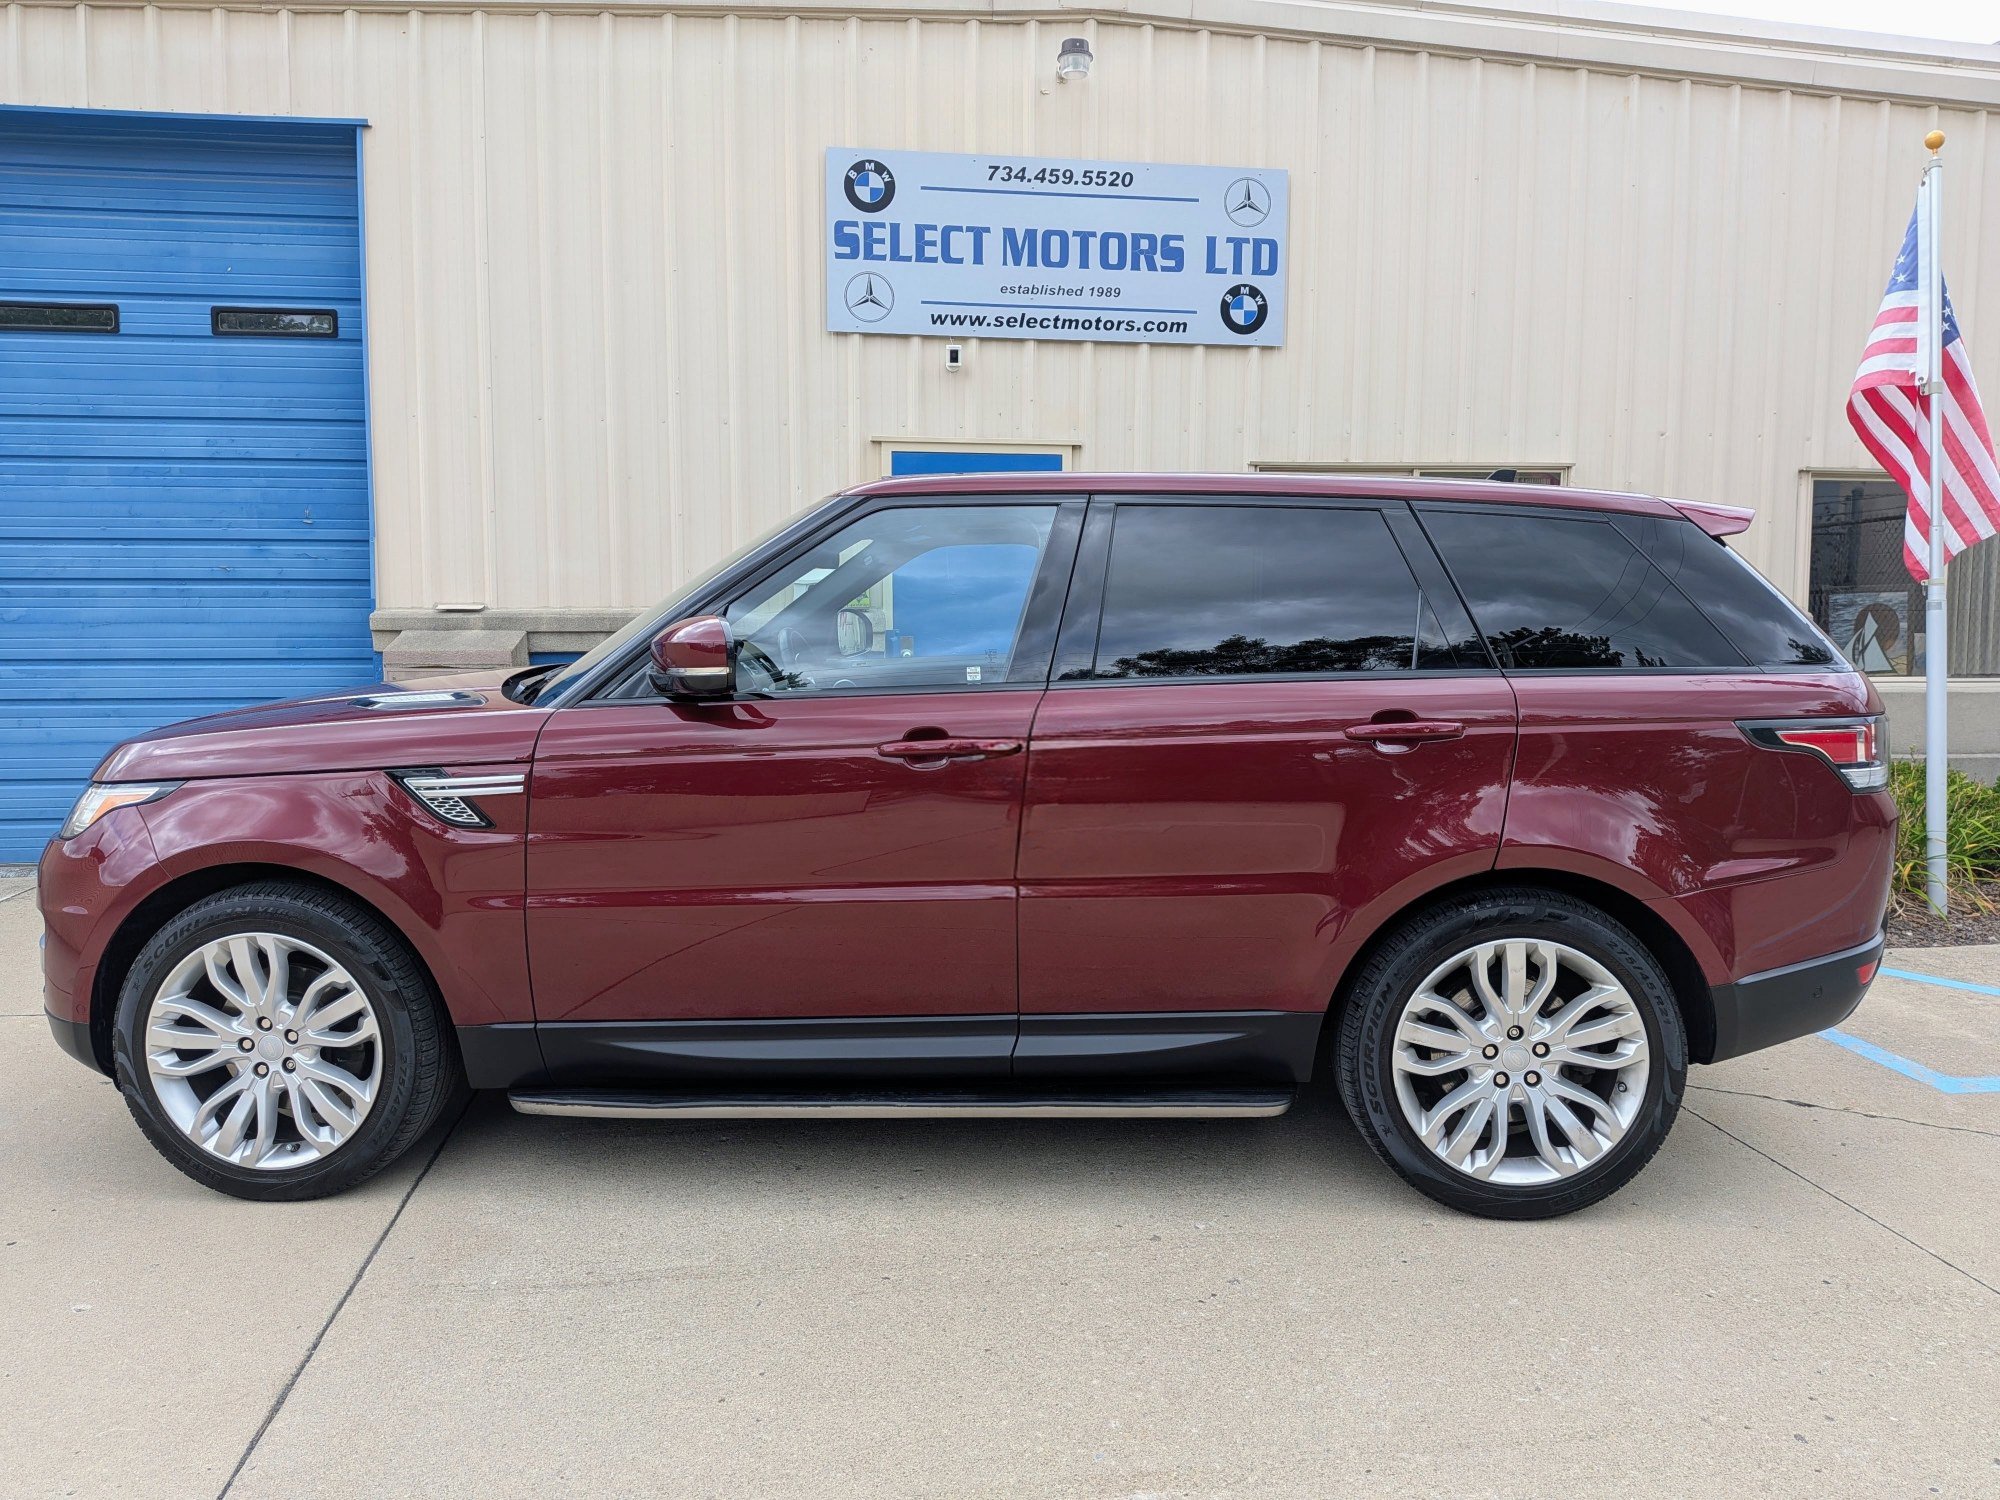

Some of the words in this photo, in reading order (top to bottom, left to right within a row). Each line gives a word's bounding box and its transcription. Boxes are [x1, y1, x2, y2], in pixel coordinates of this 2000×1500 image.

[847, 162, 892, 182] BMW
[987, 165, 1134, 188] 734.459.5520
[834, 220, 991, 265] SELECT
[1002, 227, 1185, 273] MOTORS
[1205, 235, 1279, 277] LTD
[1000, 282, 1084, 297] established
[1089, 286, 1122, 299] 1989
[1224, 286, 1265, 306] BMW
[930, 313, 1188, 333] www.selectmotors.com
[1363, 984, 1393, 1116] SCORPION
